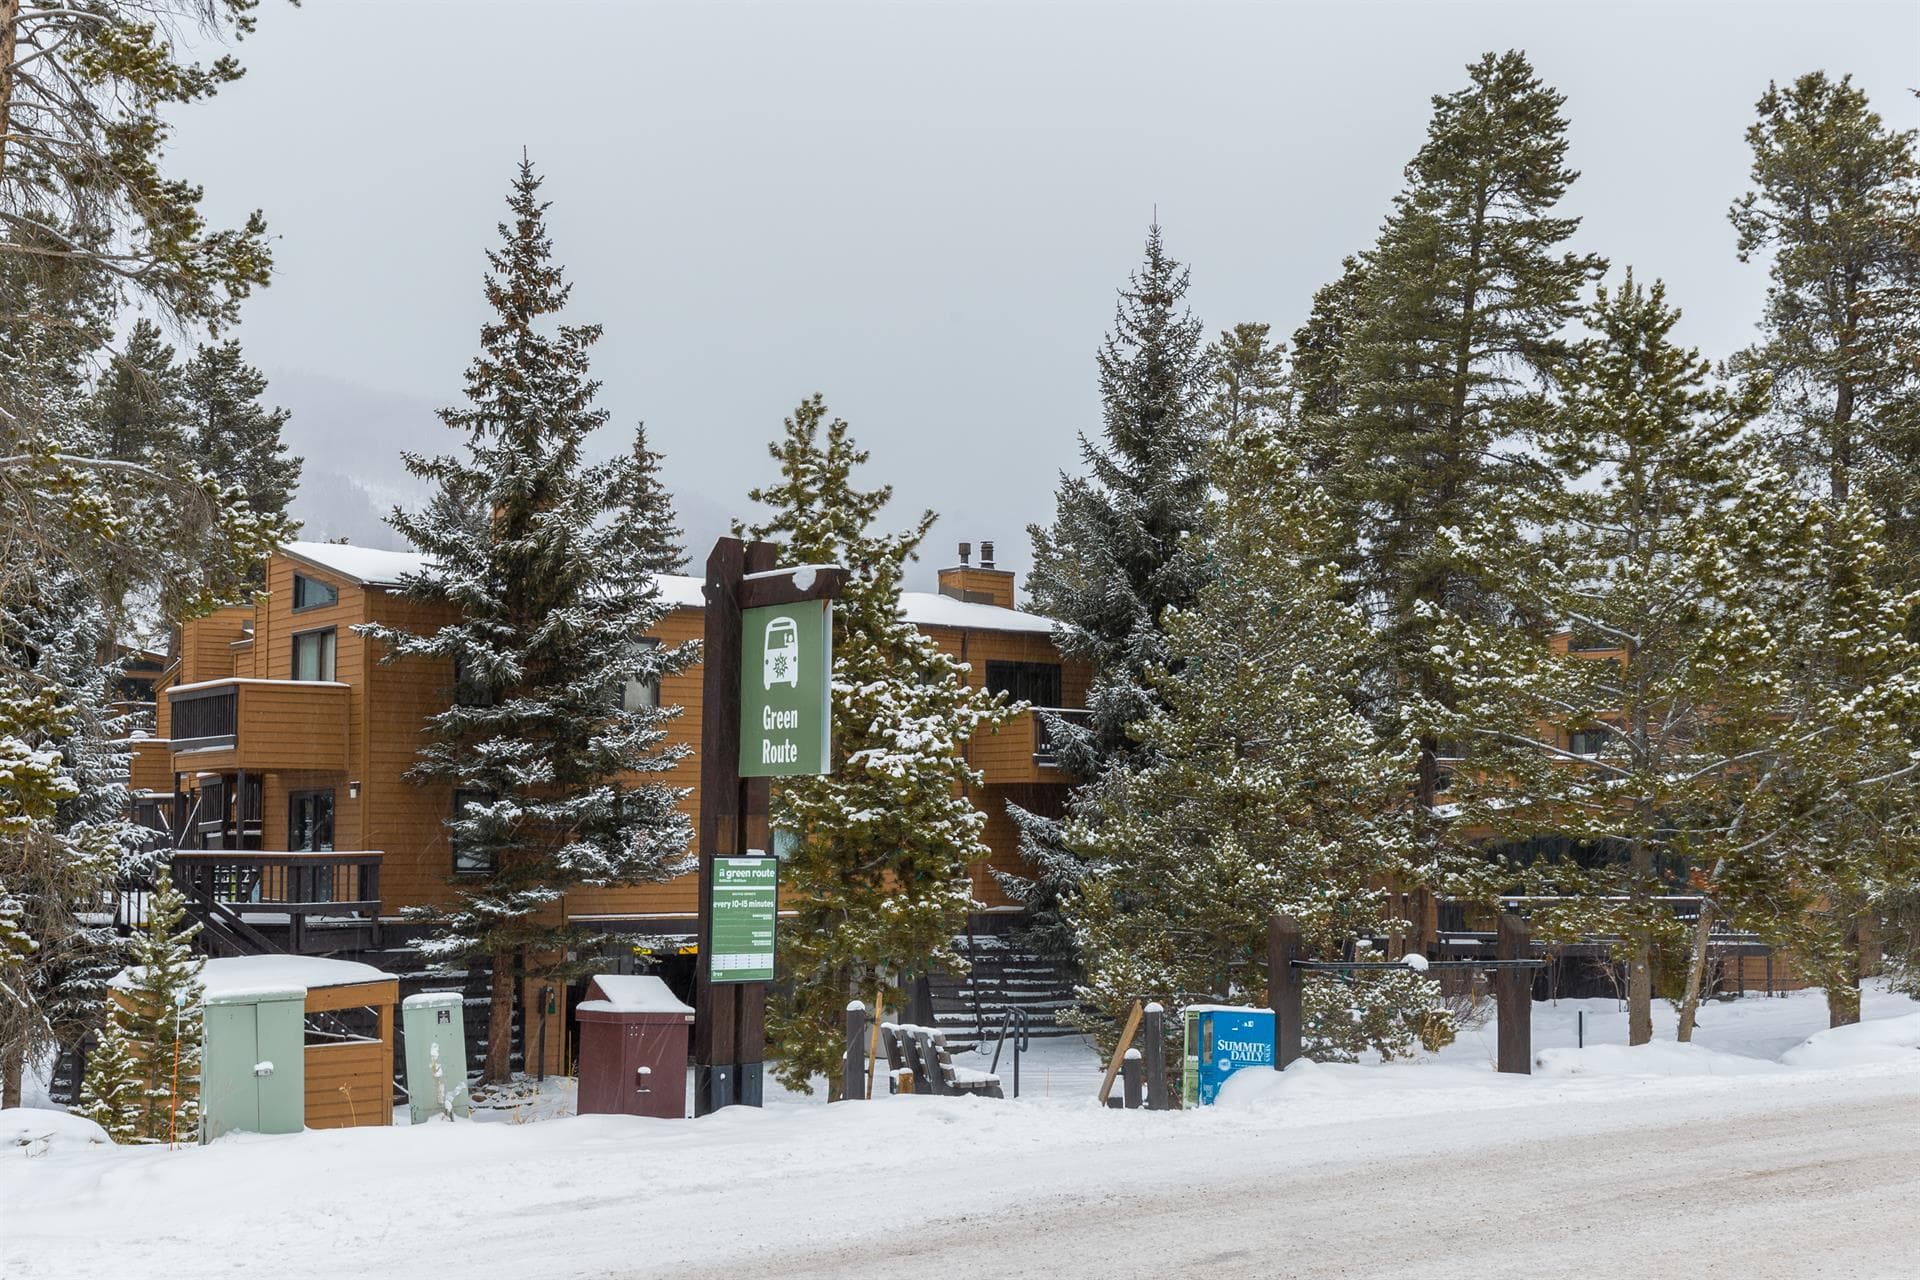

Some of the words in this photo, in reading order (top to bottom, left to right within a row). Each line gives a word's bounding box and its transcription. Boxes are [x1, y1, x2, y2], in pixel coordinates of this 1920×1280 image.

[763, 704, 798, 730] Green
[763, 738, 798, 764] Route
[726, 869, 751, 879] green
[752, 868, 775, 877] route
[713, 901, 731, 909] every
[732, 900, 748, 908] 10-15
[749, 900, 774, 908] minutes
[1217, 1039, 1265, 1052] SUMMIT
[1231, 1050, 1264, 1062] DAILY
